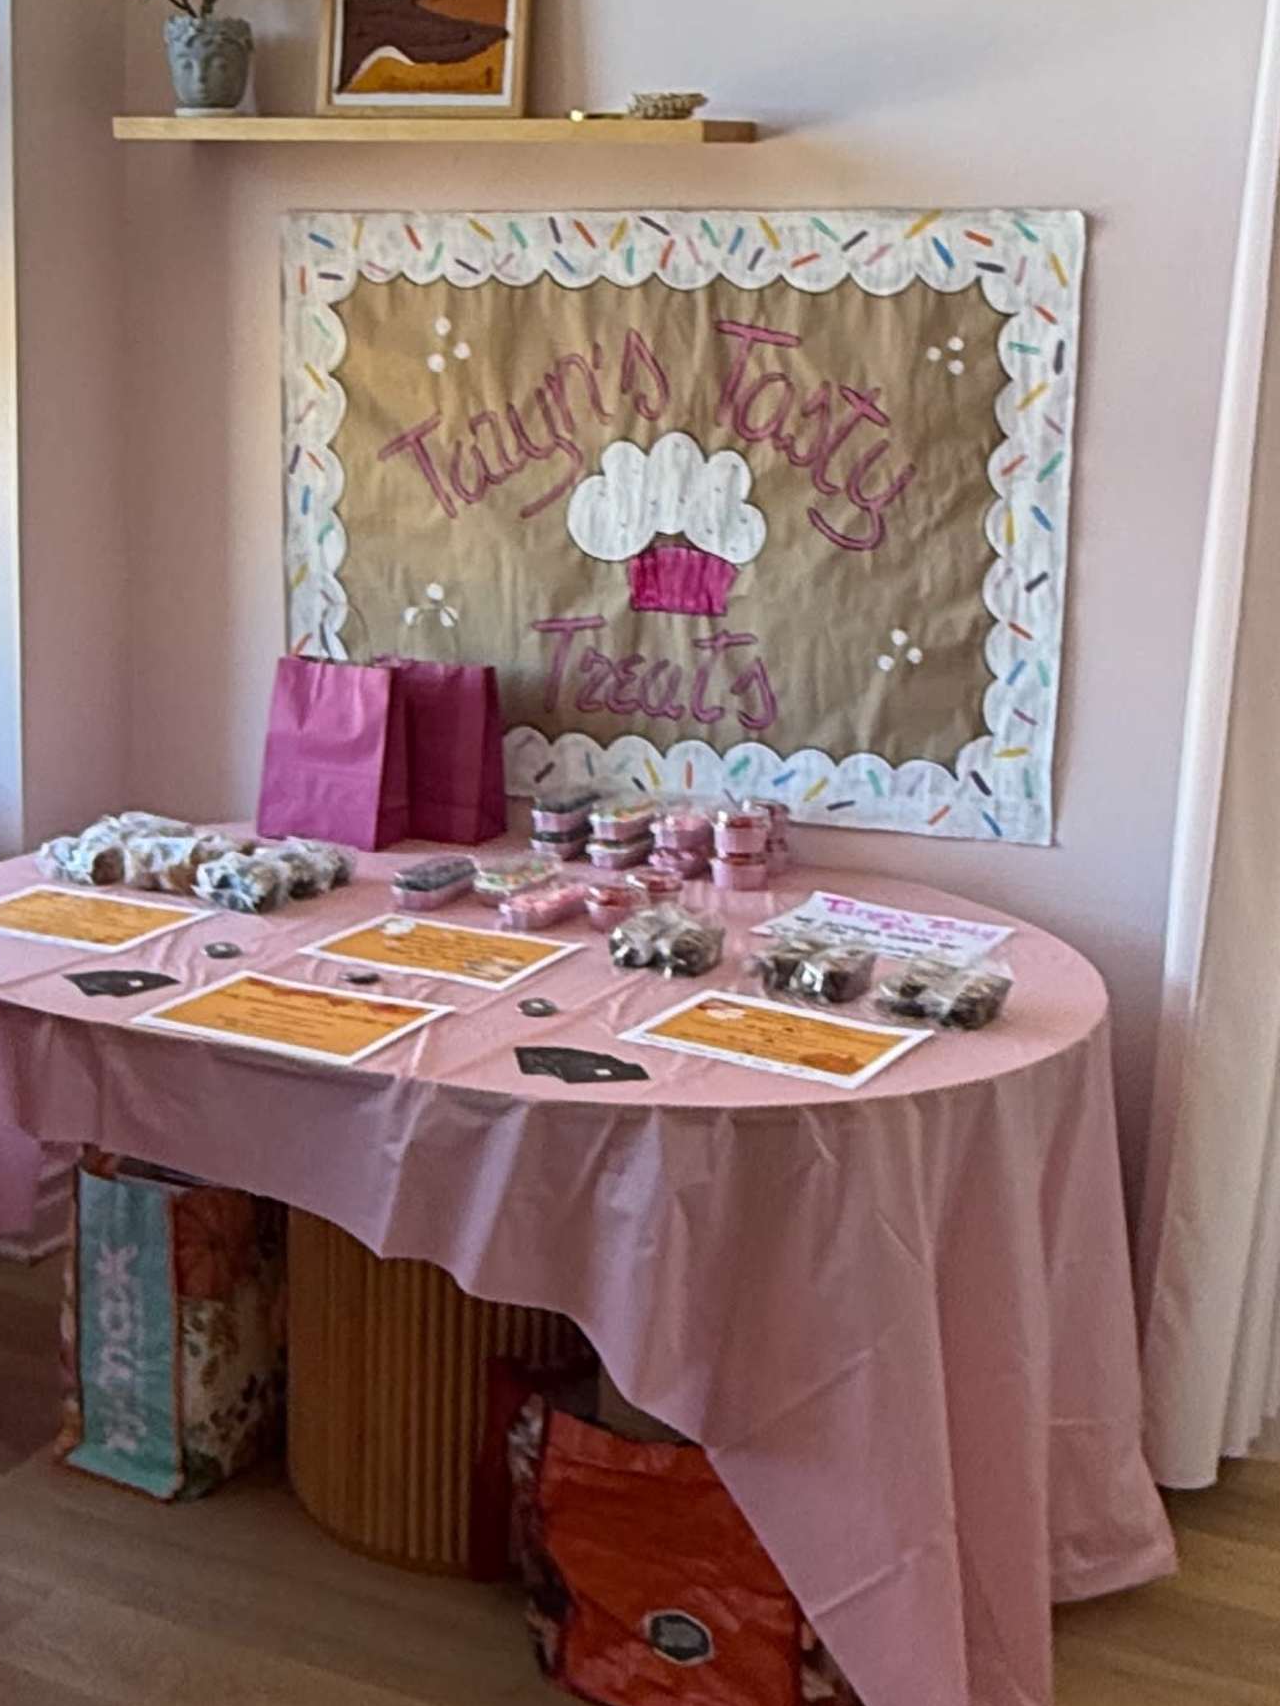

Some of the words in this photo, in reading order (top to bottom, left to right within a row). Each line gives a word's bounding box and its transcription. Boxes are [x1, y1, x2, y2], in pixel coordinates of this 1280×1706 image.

[376, 327, 670, 519] Taryn's
[715, 320, 917, 552] Tasty
[529, 613, 778, 731] Treats
